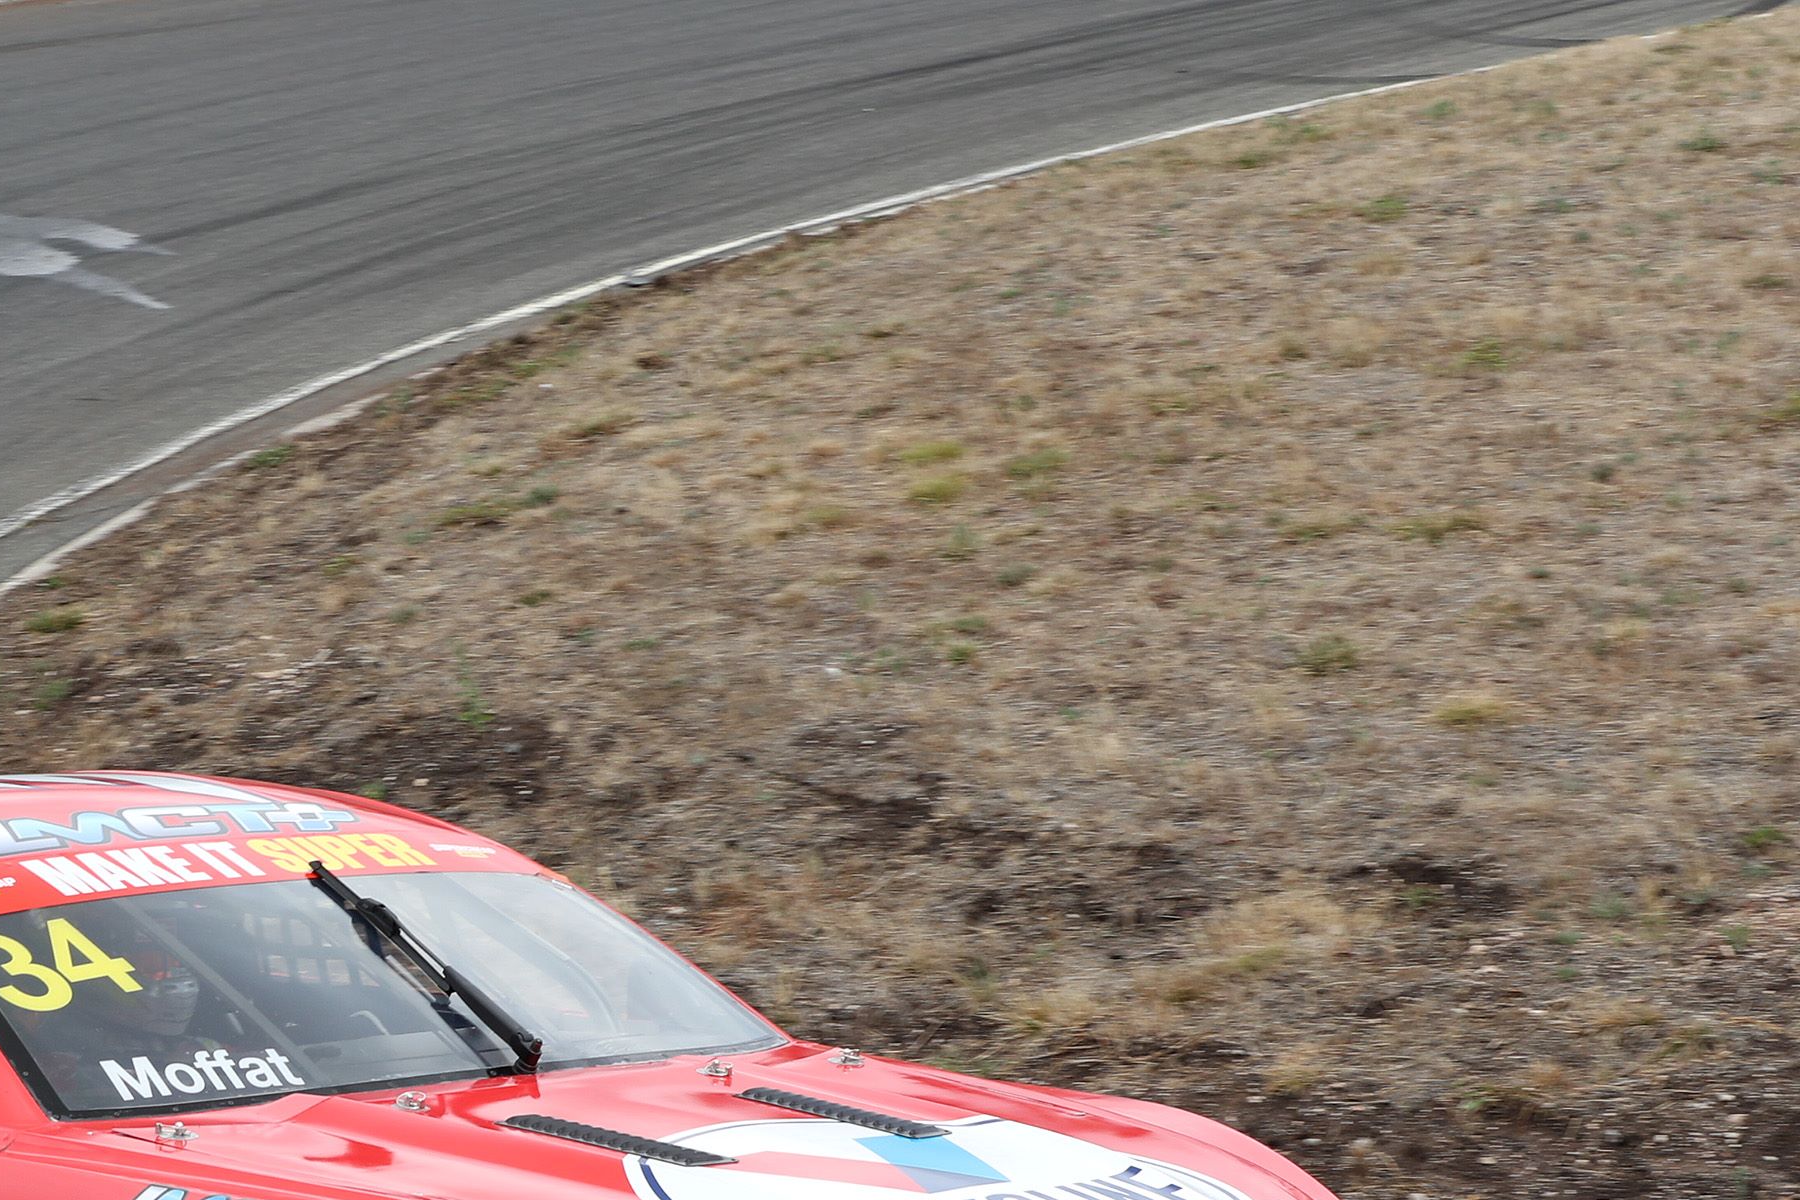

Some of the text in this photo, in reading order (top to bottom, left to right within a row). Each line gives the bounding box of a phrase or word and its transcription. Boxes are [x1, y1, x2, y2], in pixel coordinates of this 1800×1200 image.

[20, 833, 436, 896] MAKE IT SUPER
[99, 1048, 305, 1102] Moffat
